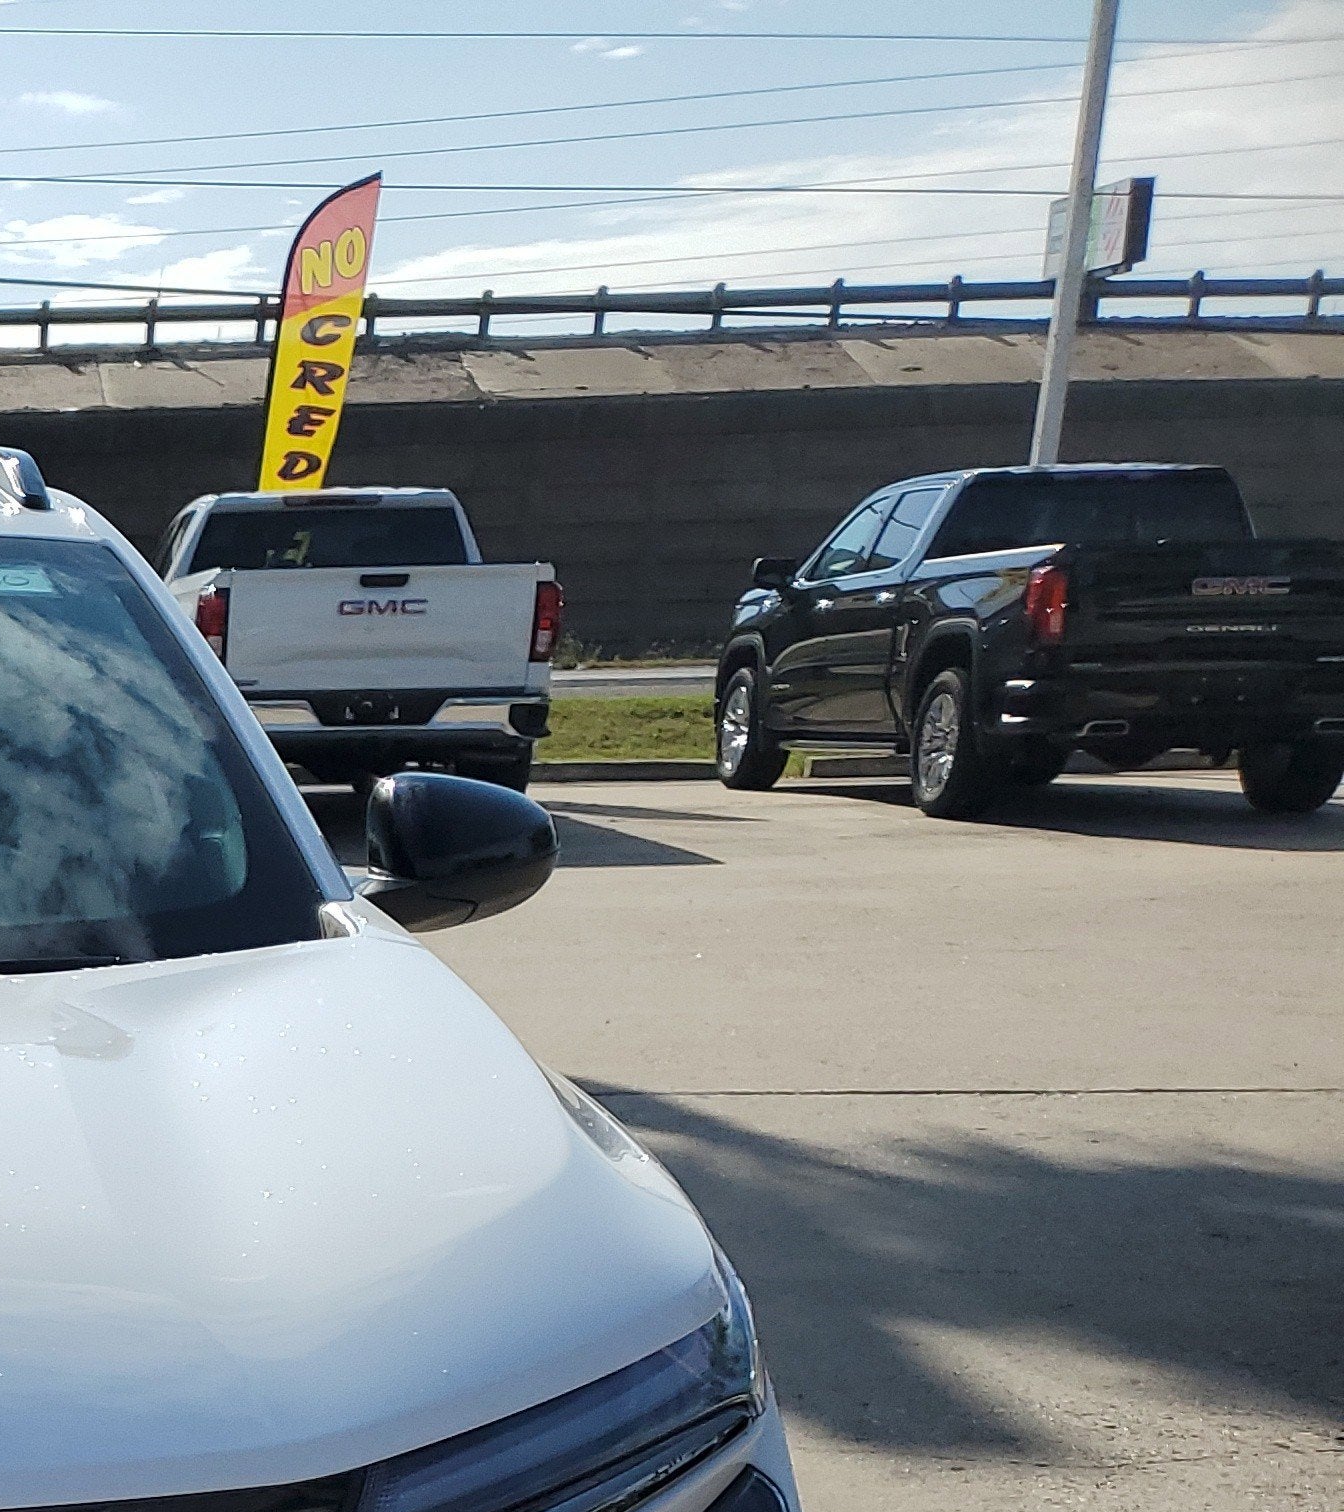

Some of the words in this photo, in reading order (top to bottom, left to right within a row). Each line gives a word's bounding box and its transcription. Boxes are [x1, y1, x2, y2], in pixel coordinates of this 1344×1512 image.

[301, 226, 367, 295] NO
[276, 313, 352, 482] CRED
[338, 598, 429, 616] GMC
[1191, 576, 1291, 596] GMC
